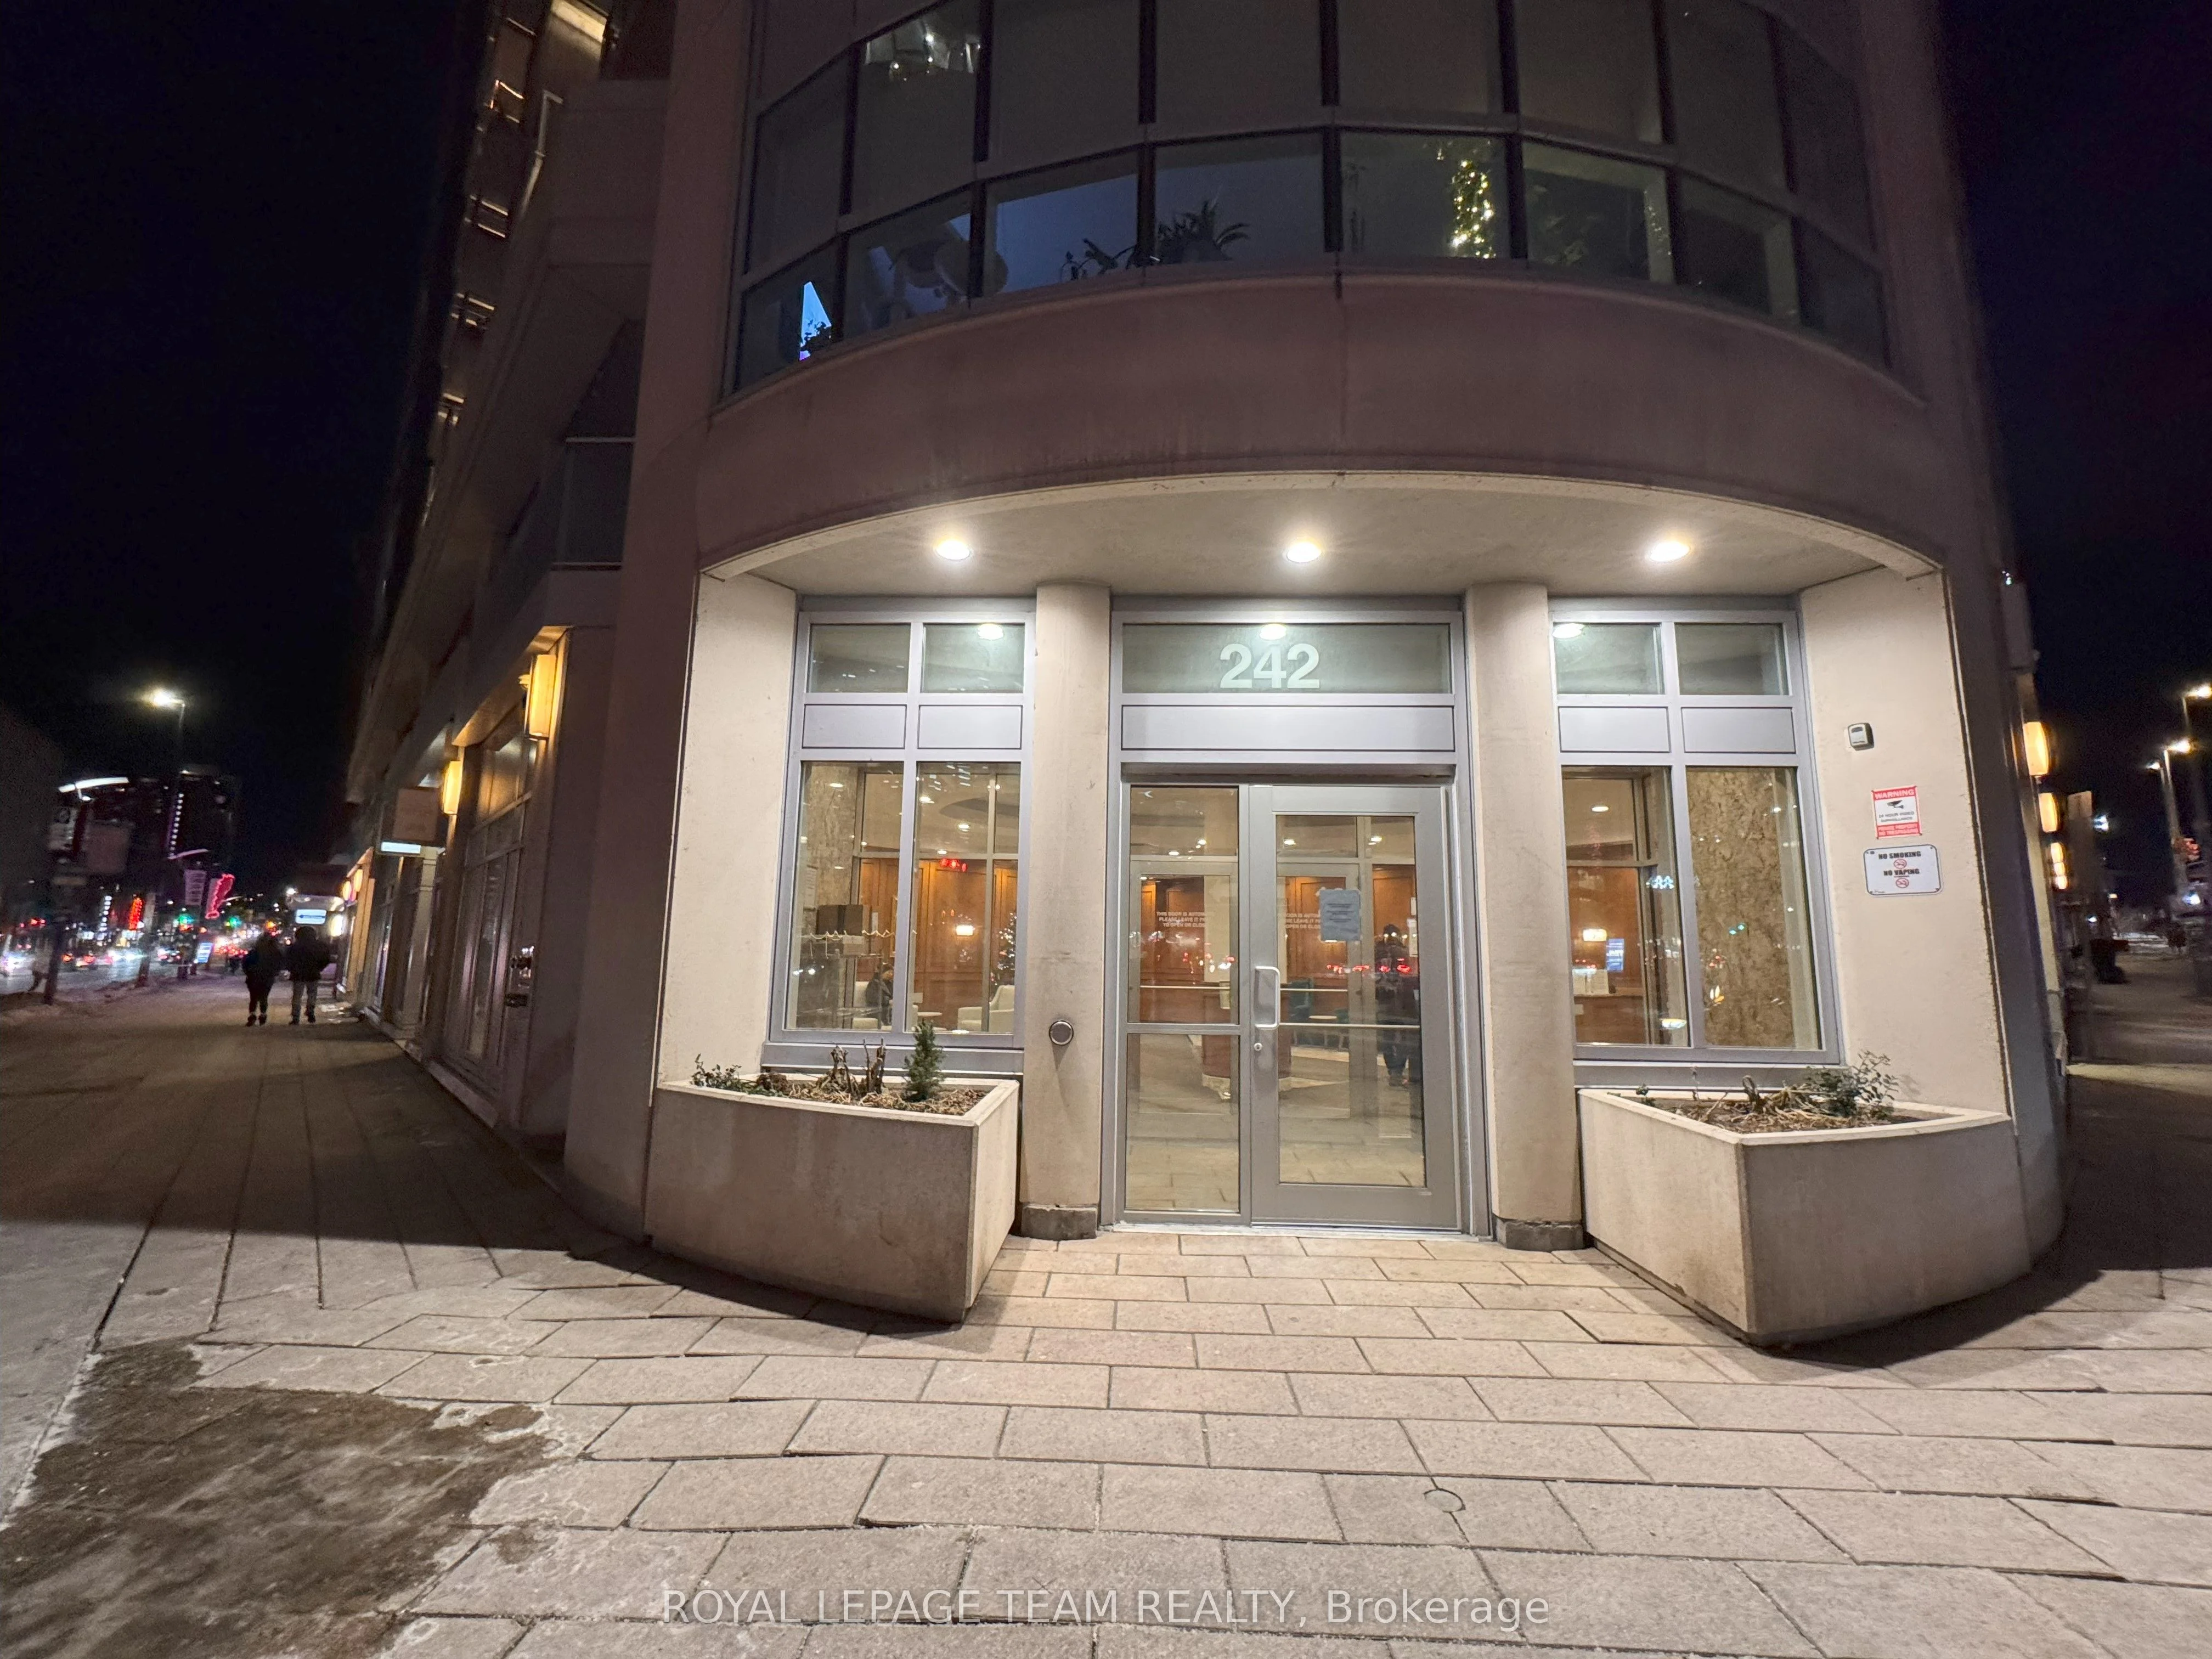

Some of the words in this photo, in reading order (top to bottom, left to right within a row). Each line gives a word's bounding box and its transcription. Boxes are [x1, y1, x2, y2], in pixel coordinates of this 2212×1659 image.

[1220, 643, 1320, 689] 242
[1874, 789, 1915, 799] WARNING
[1889, 851, 1922, 859] SMOKING
